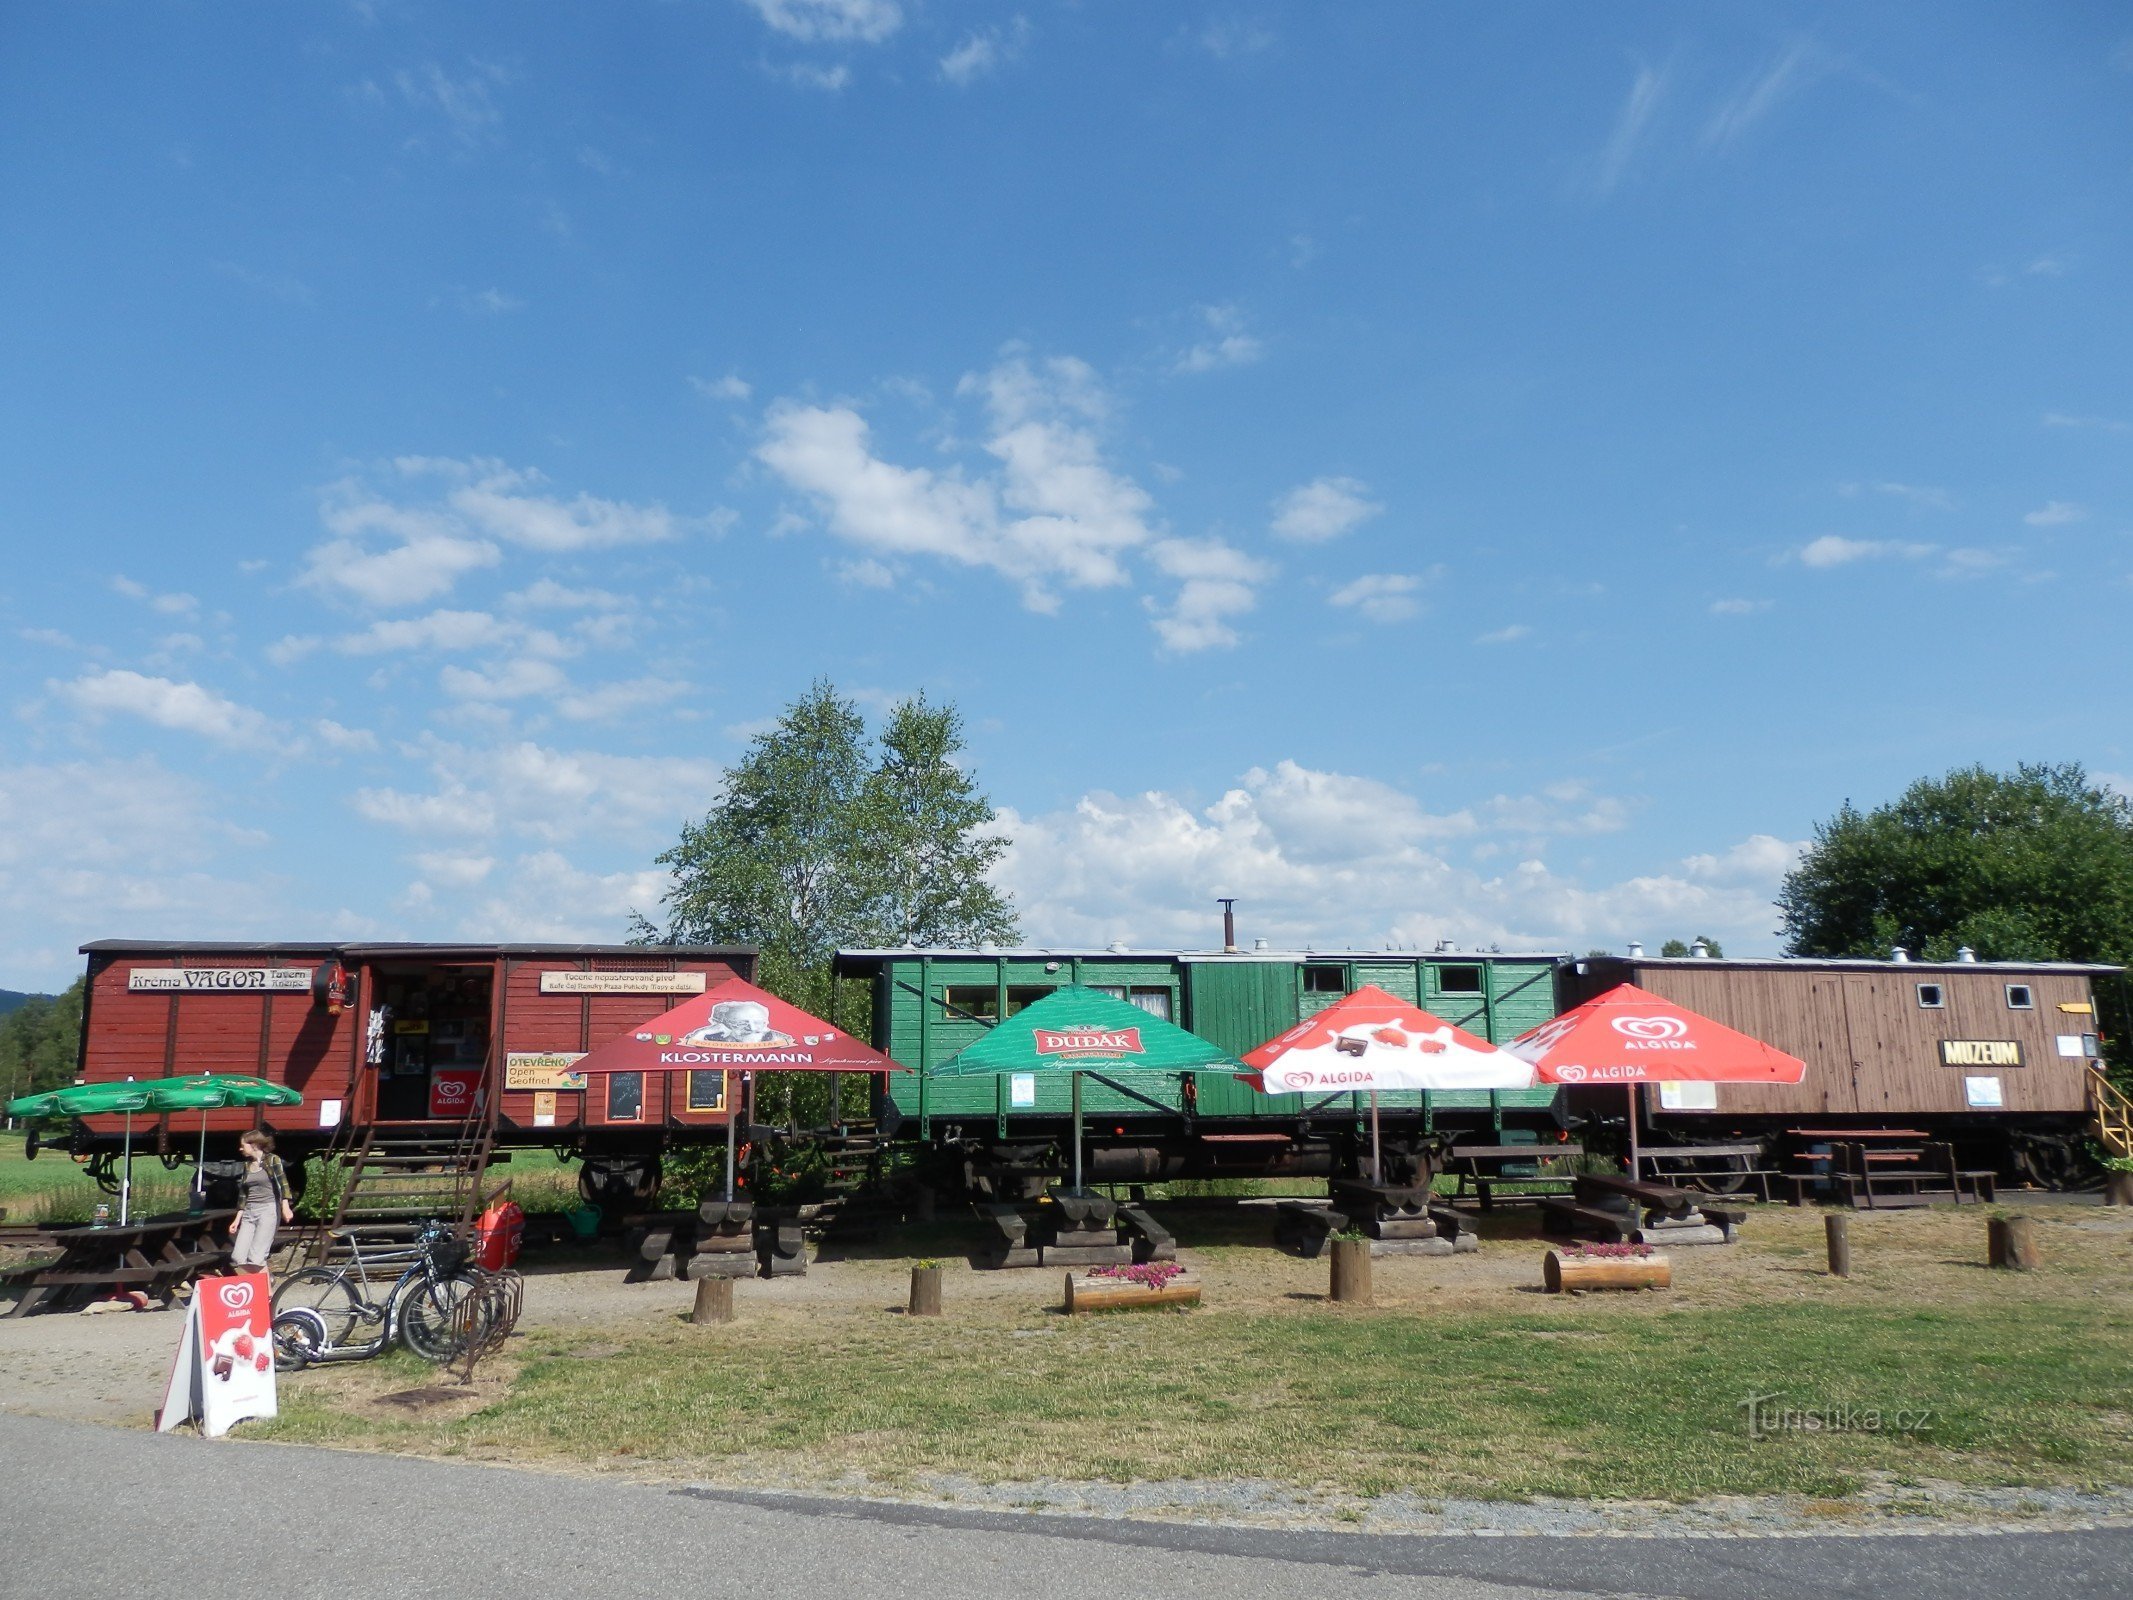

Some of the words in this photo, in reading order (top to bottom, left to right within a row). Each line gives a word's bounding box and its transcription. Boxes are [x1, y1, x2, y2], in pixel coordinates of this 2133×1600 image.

[133, 976, 181, 988] Krčma
[183, 970, 266, 988] VAGON
[269, 970, 306, 979] Tavern
[1624, 1040, 1694, 1050] ALGIDA
[660, 1053, 812, 1063] KLOSTERMANN
[1943, 1041, 2020, 1065] MUZEUM
[509, 1067, 535, 1077] Open
[1591, 1066, 1646, 1079] ALGIDA
[1319, 1072, 1373, 1085] ALGIDA
